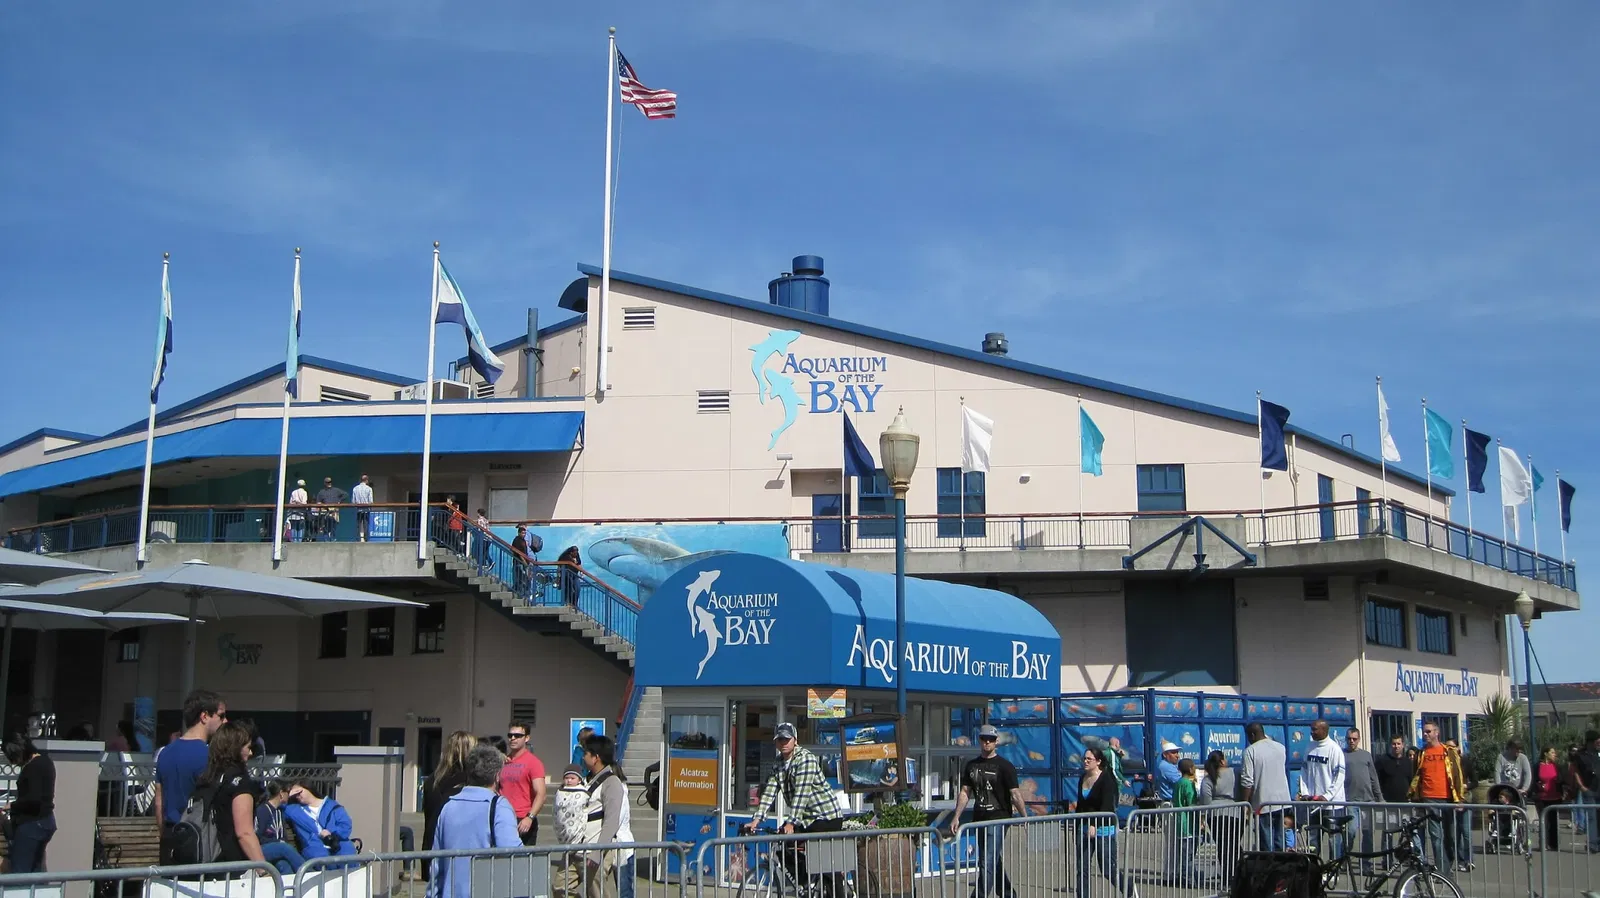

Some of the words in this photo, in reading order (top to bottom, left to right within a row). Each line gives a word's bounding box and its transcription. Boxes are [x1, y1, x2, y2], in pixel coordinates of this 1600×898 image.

[781, 353, 887, 379] AQUARIUM
[838, 374, 853, 383] OF
[854, 374, 875, 383] THE
[808, 380, 884, 414] BAY
[706, 591, 778, 614] AQUARIUM
[744, 610, 754, 618] OF
[756, 609, 771, 617] THE
[724, 615, 776, 646] BAY
[236, 650, 261, 665] BAY
[846, 624, 970, 683] AQUARIUM
[971, 660, 987, 677] OF
[989, 662, 1009, 678] THE
[1011, 640, 1051, 681] BAY
[1395, 660, 1445, 702] AQUARIUM
[1445, 683, 1452, 695] OF
[1452, 683, 1461, 696] THE
[1460, 667, 1478, 697] BAY
[1208, 729, 1241, 747] Aquarium
[679, 767, 709, 777] Alcatraz
[673, 779, 714, 790] Information
